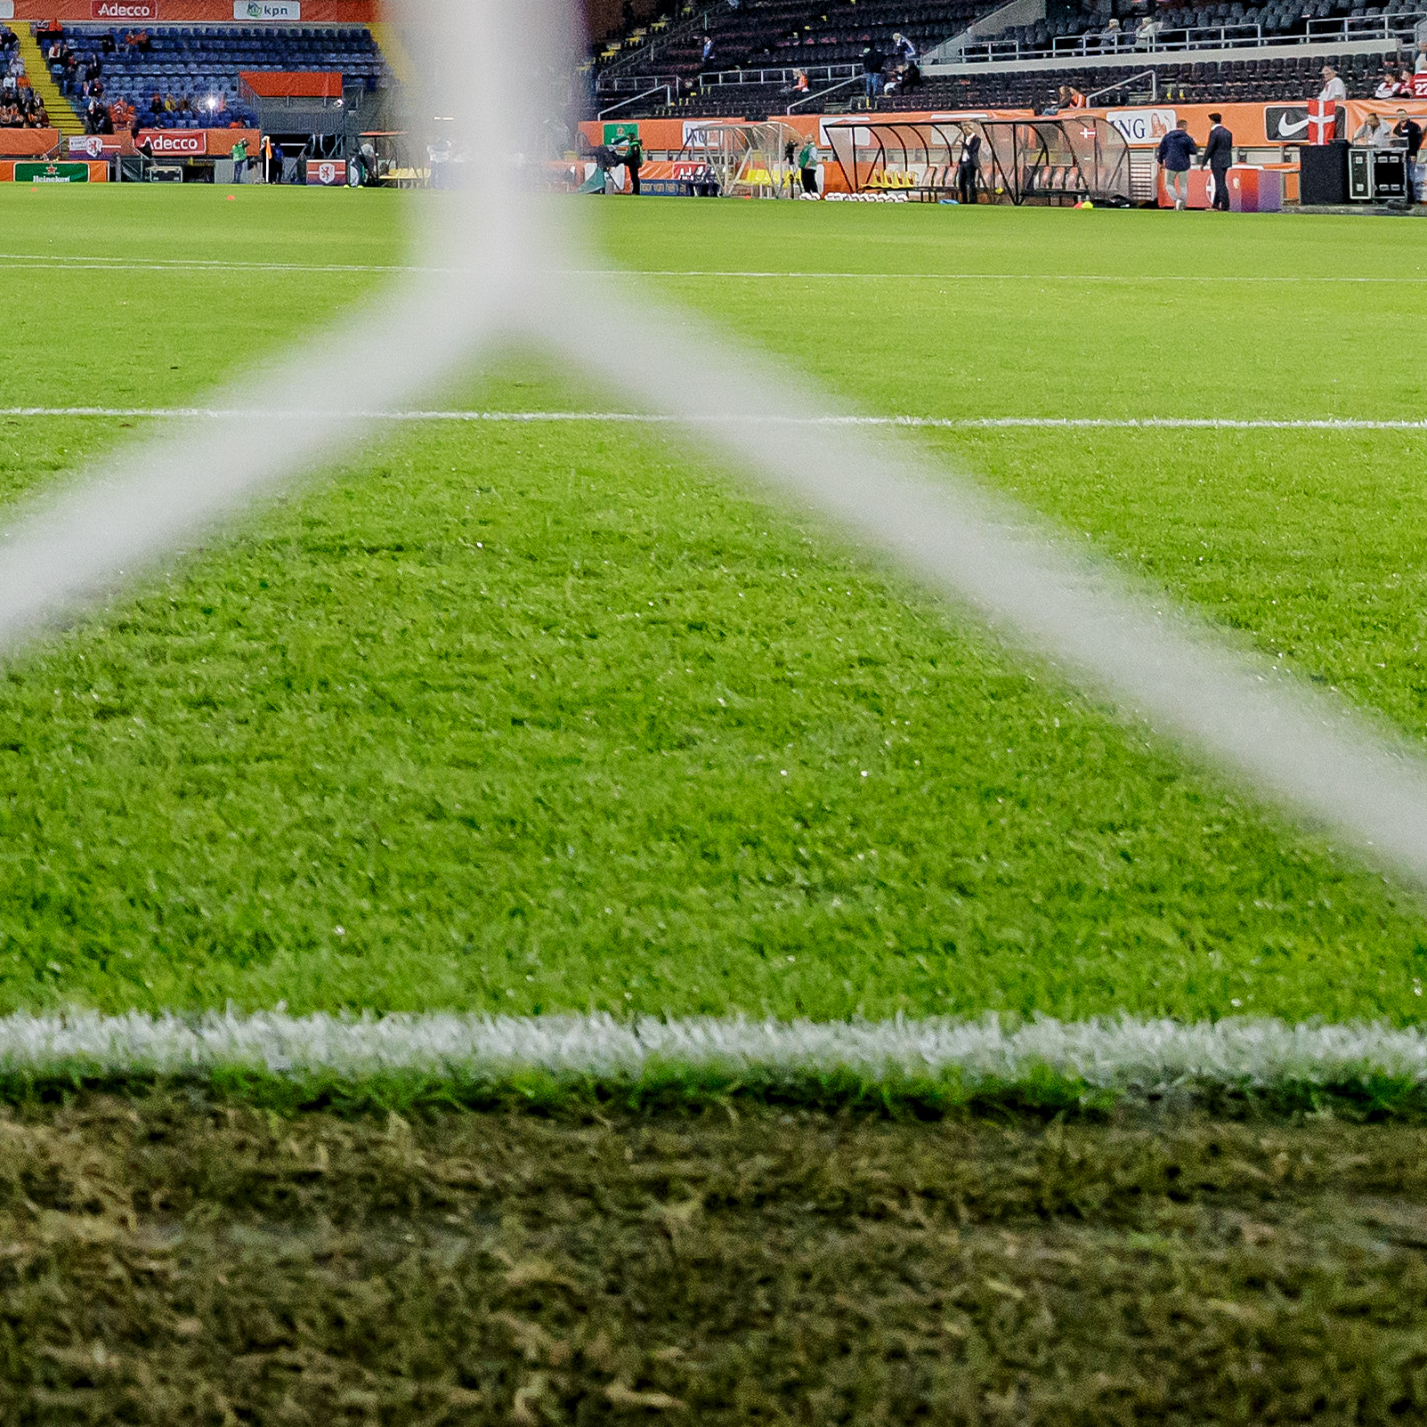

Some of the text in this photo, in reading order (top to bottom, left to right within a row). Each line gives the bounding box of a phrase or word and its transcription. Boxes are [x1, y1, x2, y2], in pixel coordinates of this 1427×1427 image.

[98, 3, 150, 17] Adecco
[264, 5, 288, 17] kpn
[141, 136, 198, 150] Adecco
